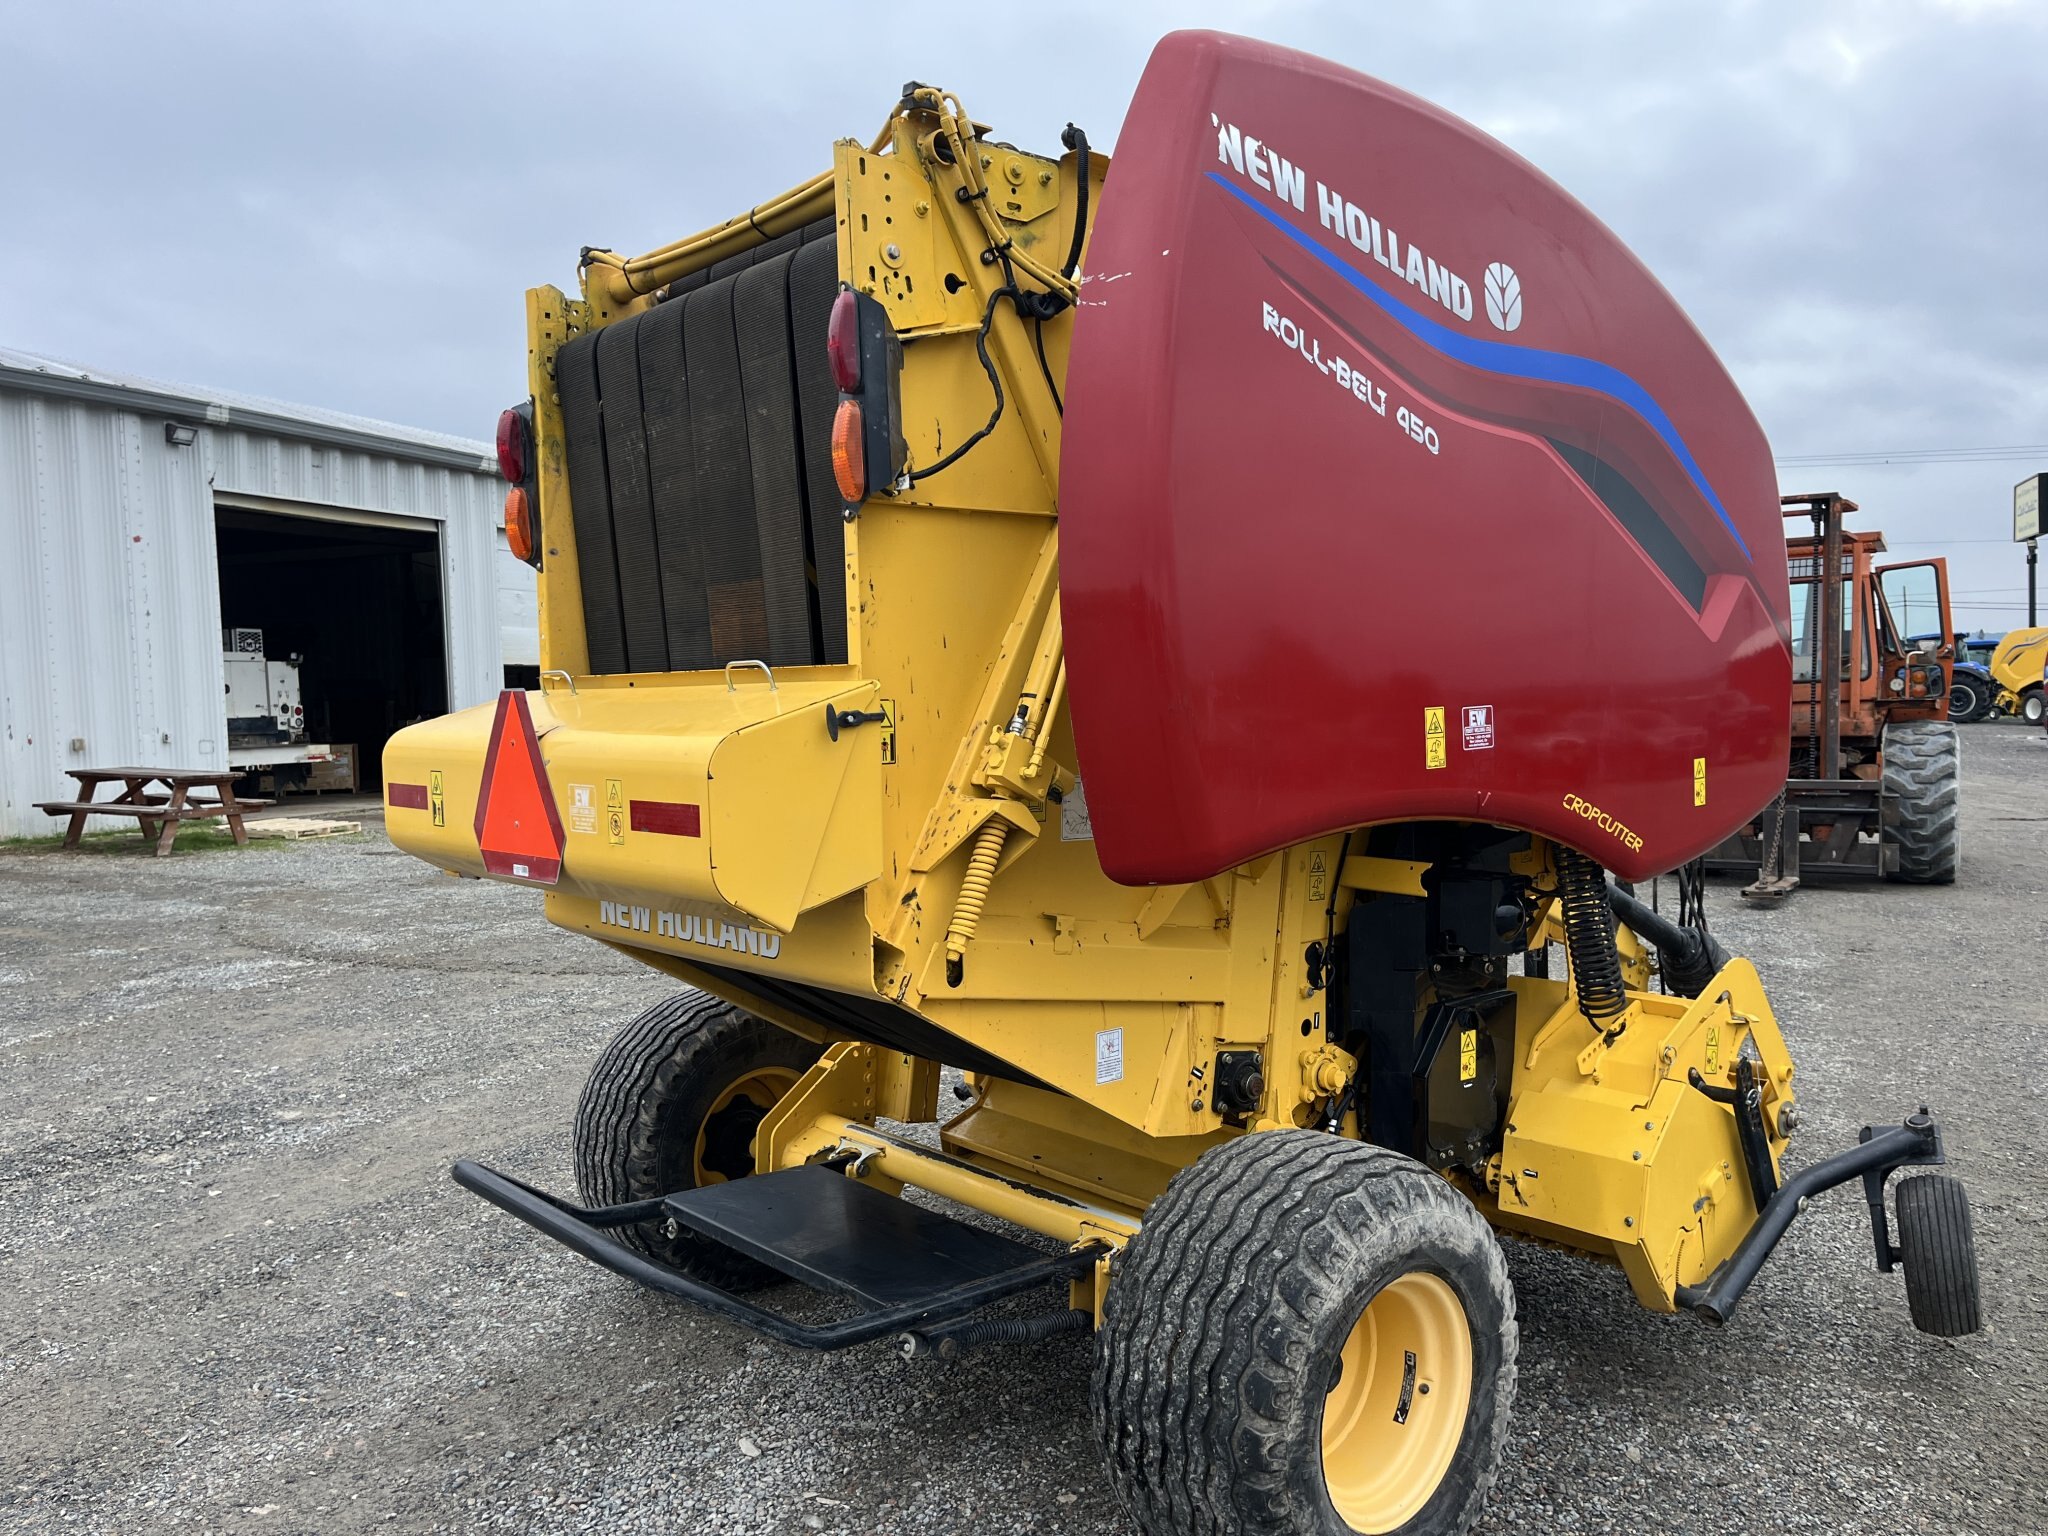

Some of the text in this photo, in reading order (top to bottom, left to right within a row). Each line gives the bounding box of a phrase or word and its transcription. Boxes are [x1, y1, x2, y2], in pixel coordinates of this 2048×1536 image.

[1211, 112, 1473, 322] NEW HOLLAND
[1262, 300, 1440, 455] ROLL-BELT 450
[1562, 793, 1644, 854] CROPCUTTER
[600, 900, 781, 960] NEW HOLLAND
